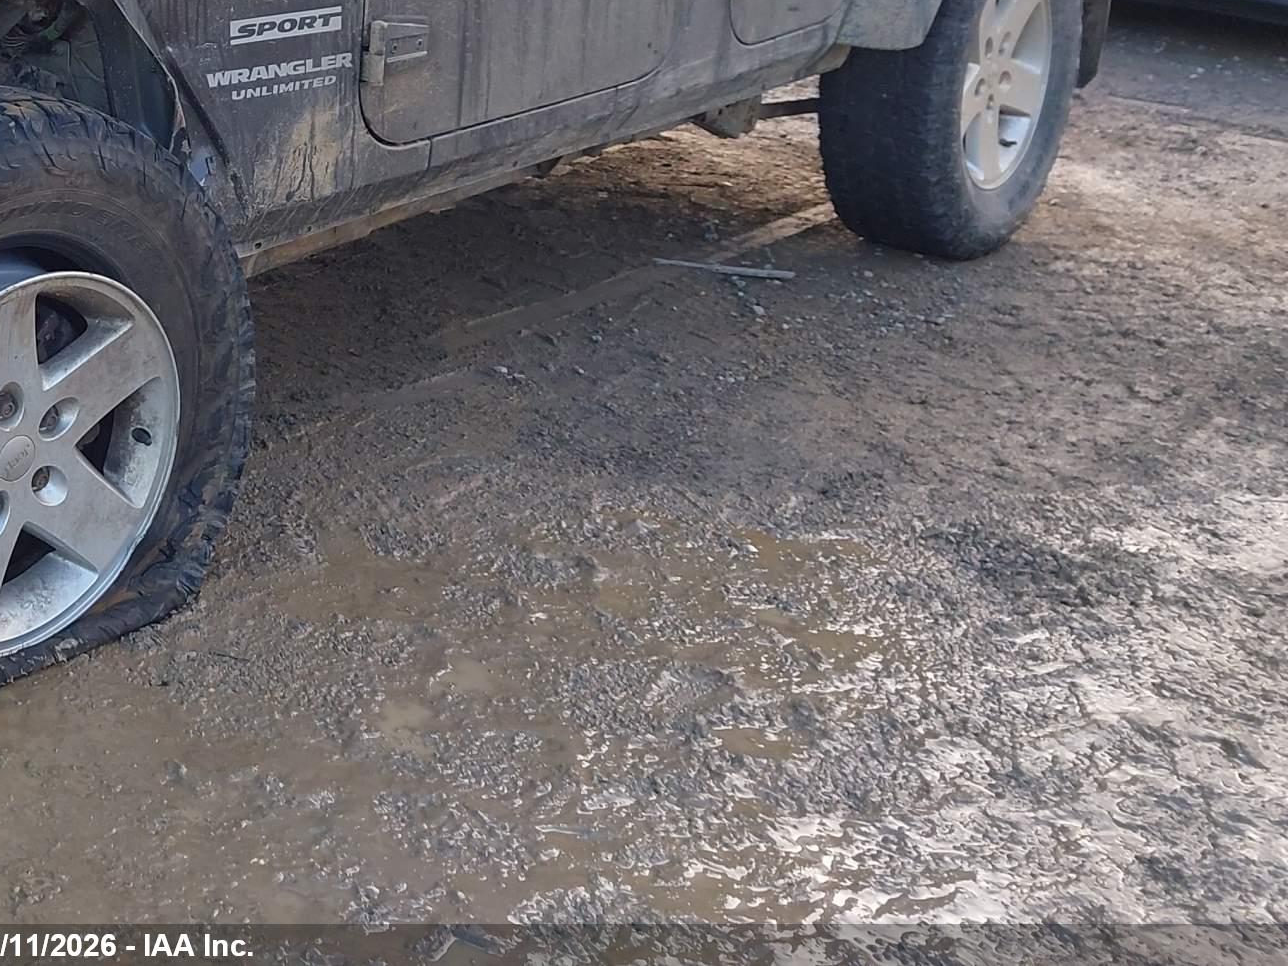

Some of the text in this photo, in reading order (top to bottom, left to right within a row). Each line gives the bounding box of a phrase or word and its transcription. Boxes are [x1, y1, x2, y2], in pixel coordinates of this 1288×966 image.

[232, 13, 341, 39] SPORT
[206, 52, 353, 88] WRANGLER
[231, 75, 337, 101] UNLIMITED
